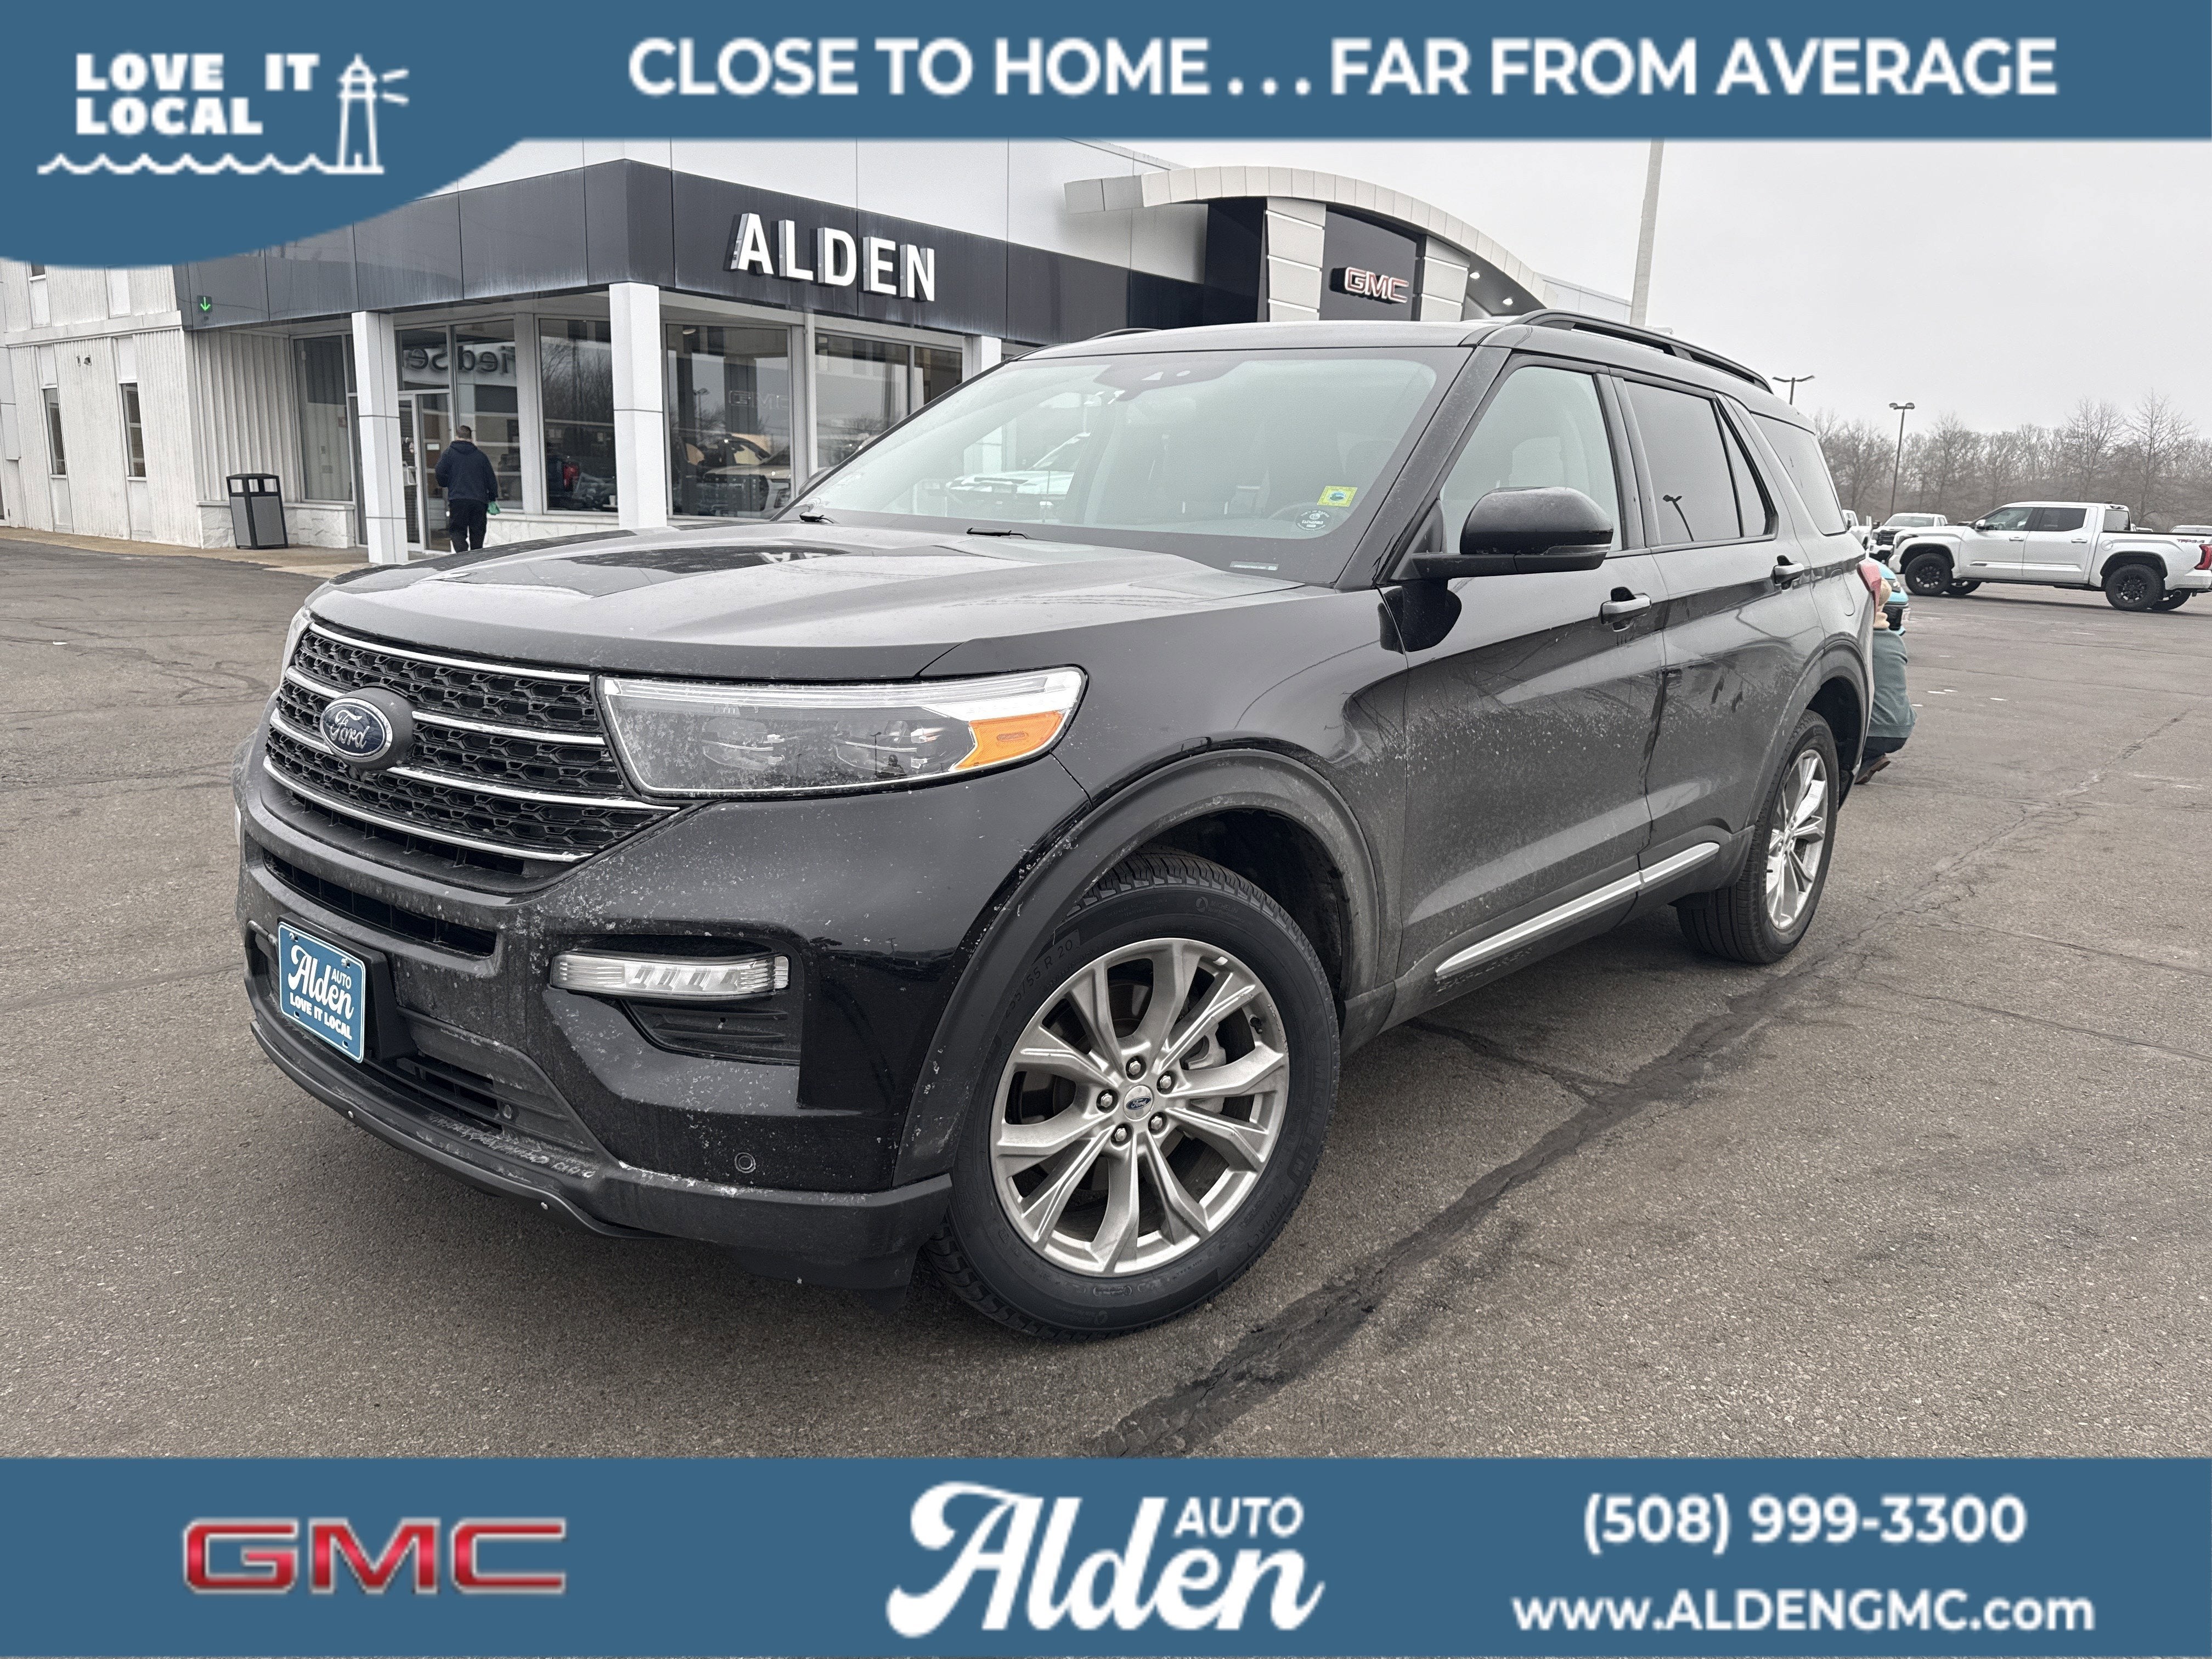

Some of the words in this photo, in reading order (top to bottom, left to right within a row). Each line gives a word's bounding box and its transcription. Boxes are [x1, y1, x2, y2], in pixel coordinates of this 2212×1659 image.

[730, 212, 935, 302] ALDEN
[1344, 267, 1409, 303] GMC
[330, 710, 370, 748] Ford
[1209, 900, 1239, 914] MICHELIN
[1043, 955, 1053, 969] R
[1058, 939, 1073, 959] 20
[288, 944, 354, 1020] Alden
[331, 968, 352, 990] AUTO
[290, 991, 313, 1016] LOVE
[314, 1006, 323, 1022] IT
[324, 1011, 353, 1041] LOCAL
[1131, 1098, 1147, 1108] Ford
[1292, 1058, 1328, 1178] MICHELIN
[1246, 1193, 1289, 1252] PRIMACY
